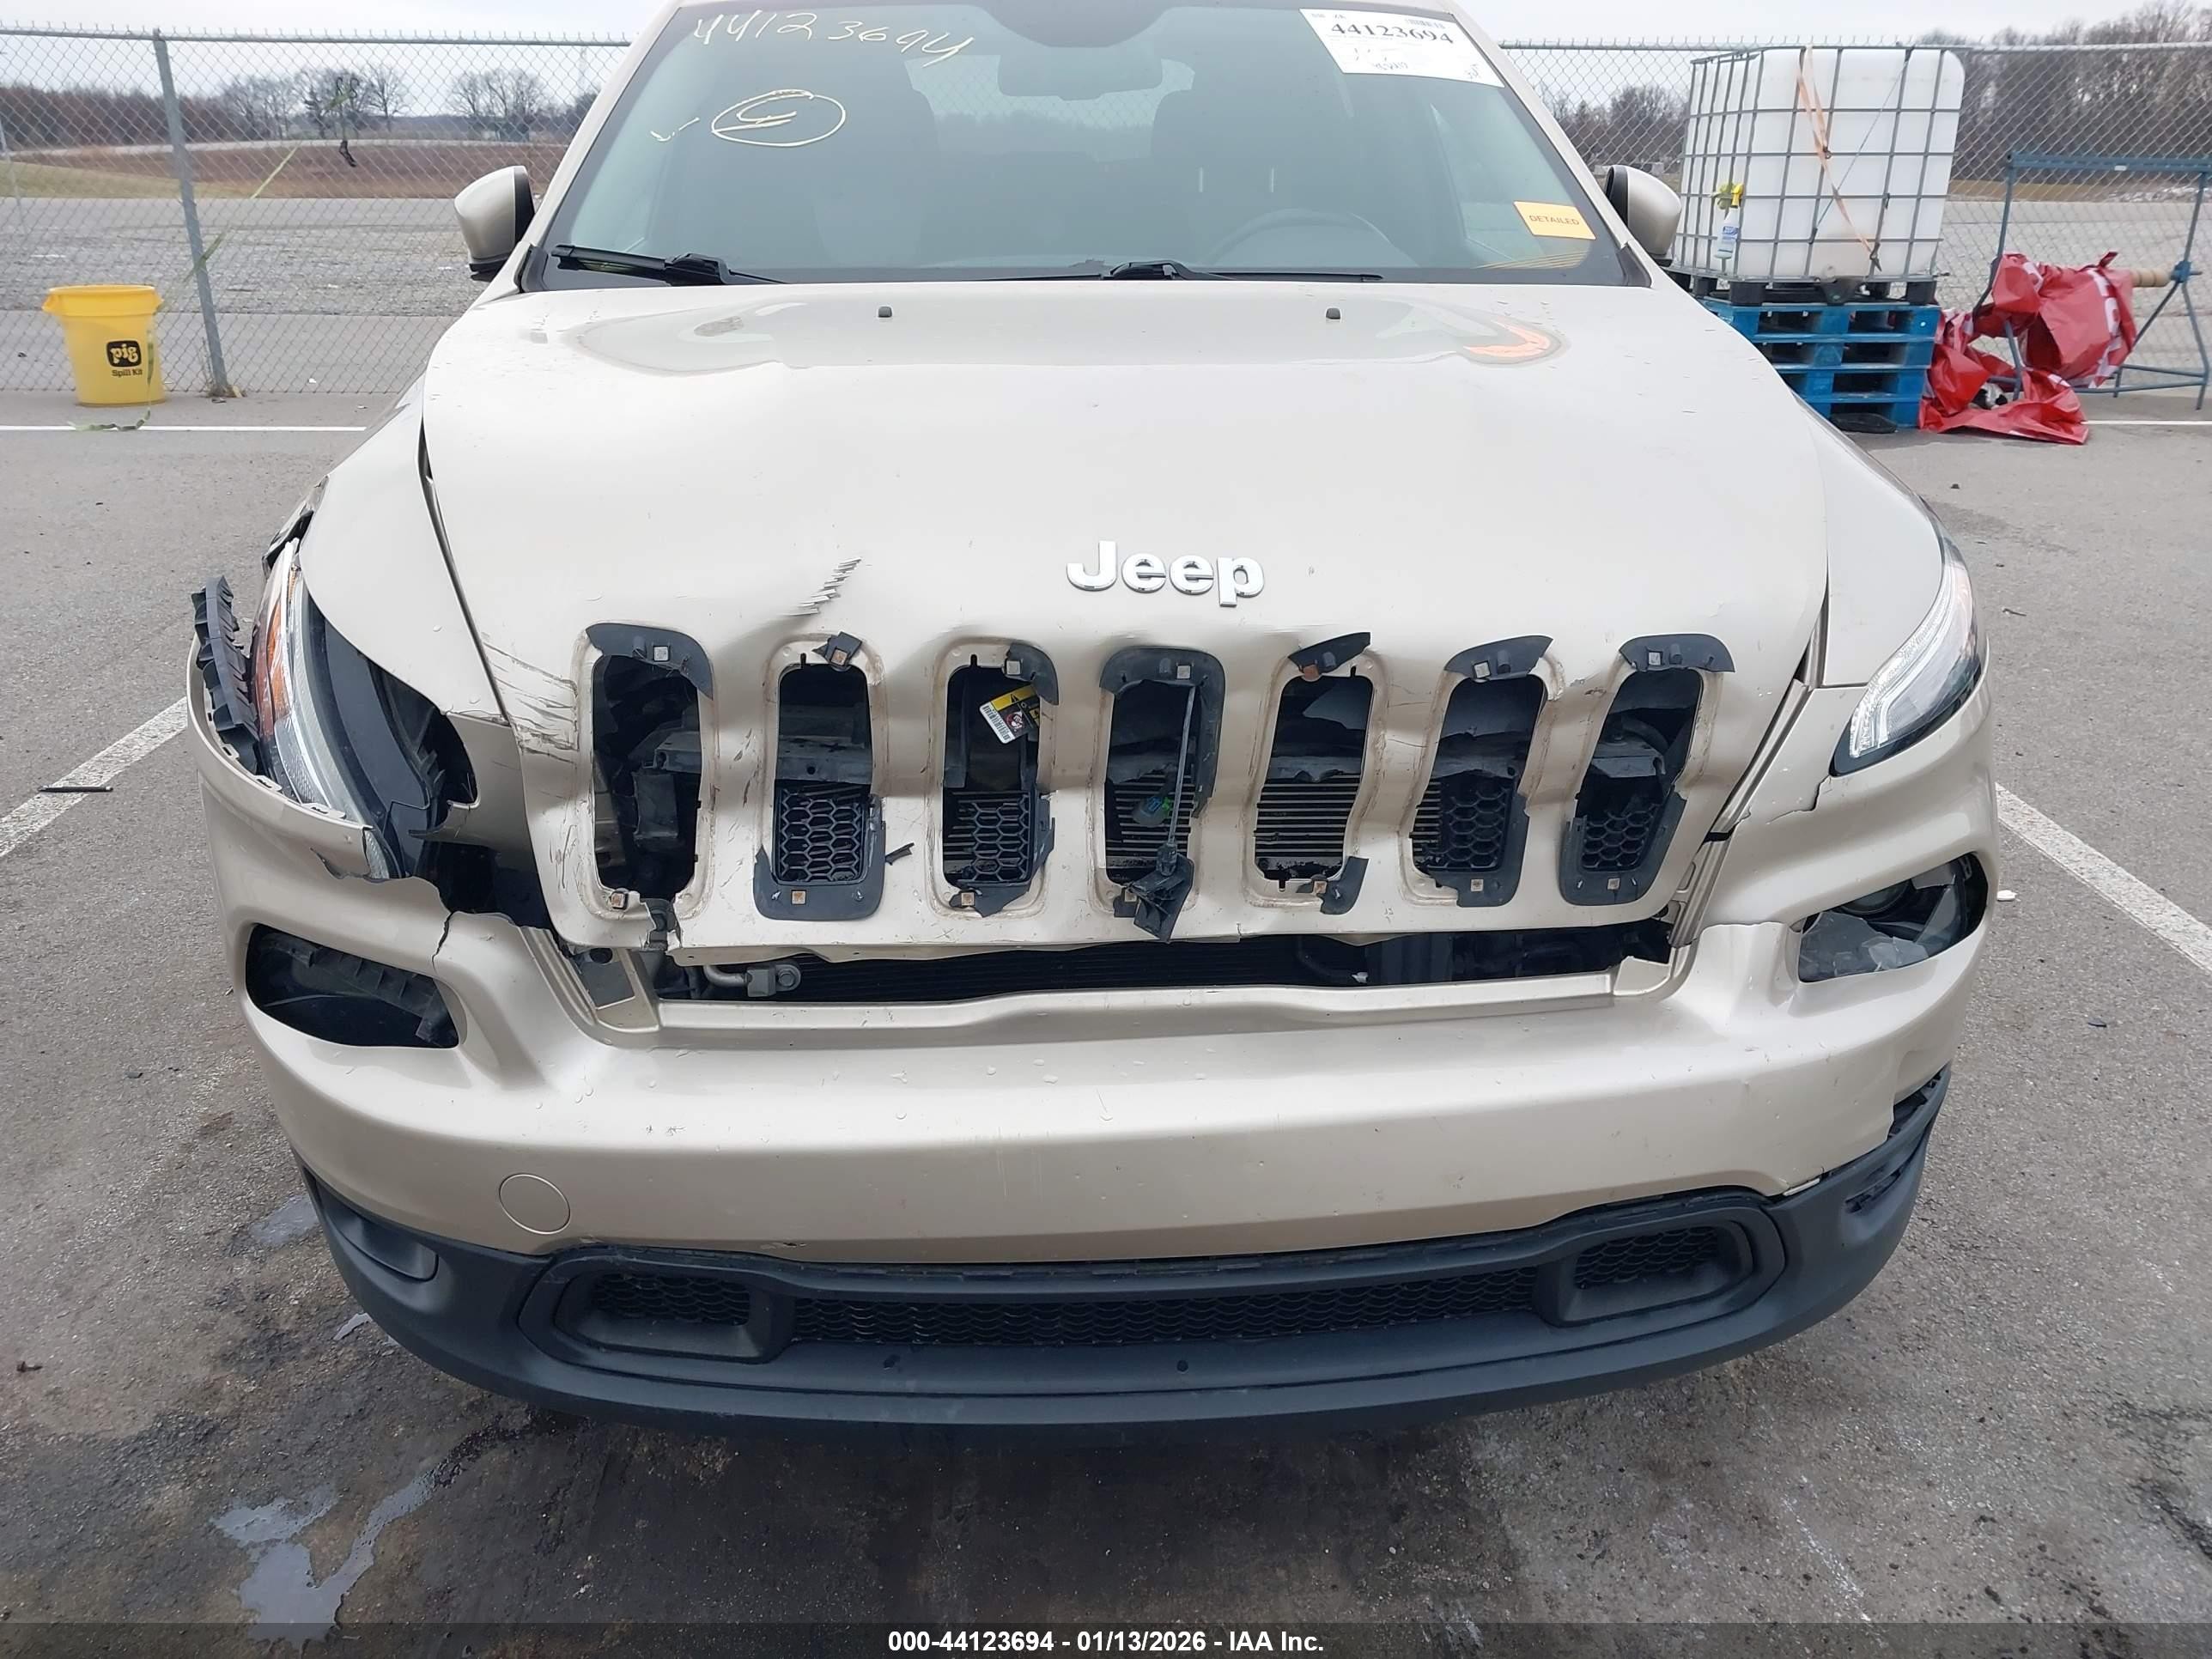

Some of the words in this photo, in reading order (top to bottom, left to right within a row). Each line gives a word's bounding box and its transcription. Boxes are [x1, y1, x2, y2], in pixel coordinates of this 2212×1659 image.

[1331, 23, 1454, 44] 44123694
[1528, 215, 1580, 226] DETAILED
[110, 343, 138, 364] pig
[112, 369, 131, 378] Spill
[1066, 540, 1265, 608] Jeep
